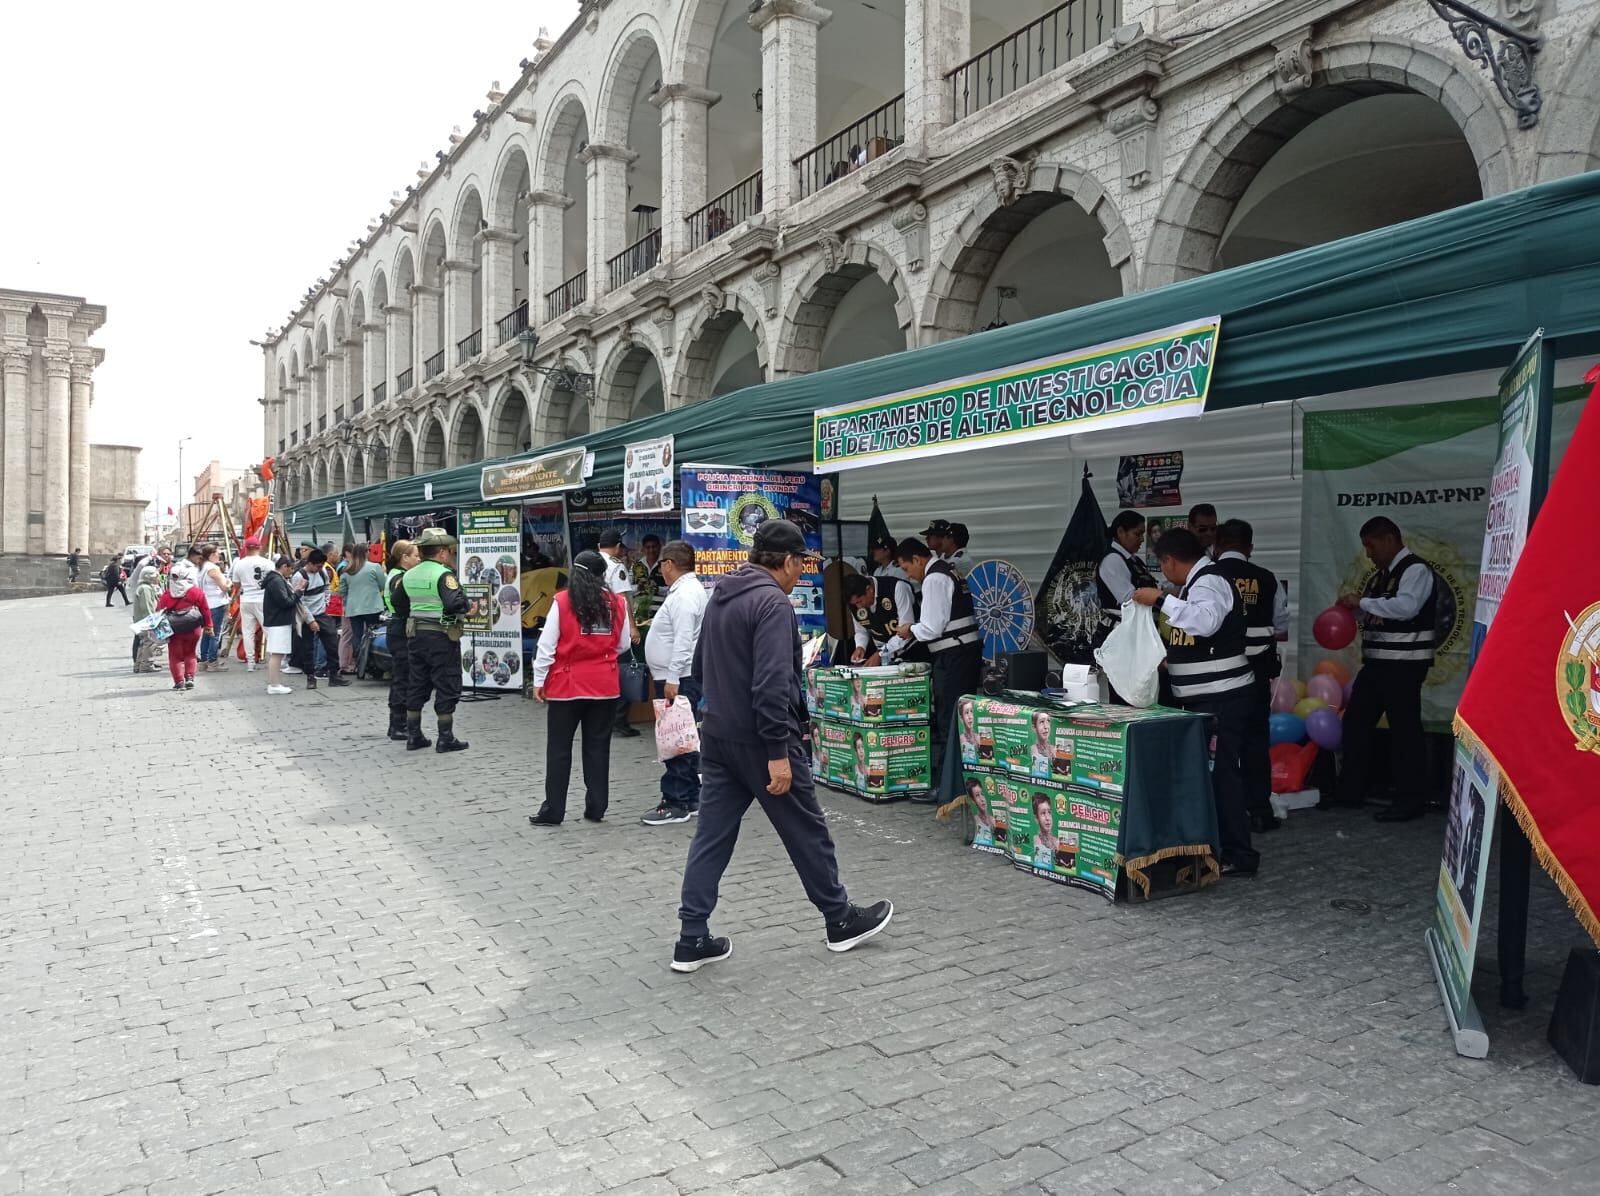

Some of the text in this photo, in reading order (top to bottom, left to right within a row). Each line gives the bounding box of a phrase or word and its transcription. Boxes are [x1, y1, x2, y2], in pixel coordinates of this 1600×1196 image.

[818, 336, 1213, 442] DEPARTAMENTO DE INVESTIGACIÓN
[823, 370, 1199, 460] DE DELITOS DE ALTA TECNOLOGIA
[1337, 486, 1486, 507] DEPINDAT-PNP
[880, 734, 915, 746] PELIGRO
[1070, 803, 1110, 822] PELIGRO
